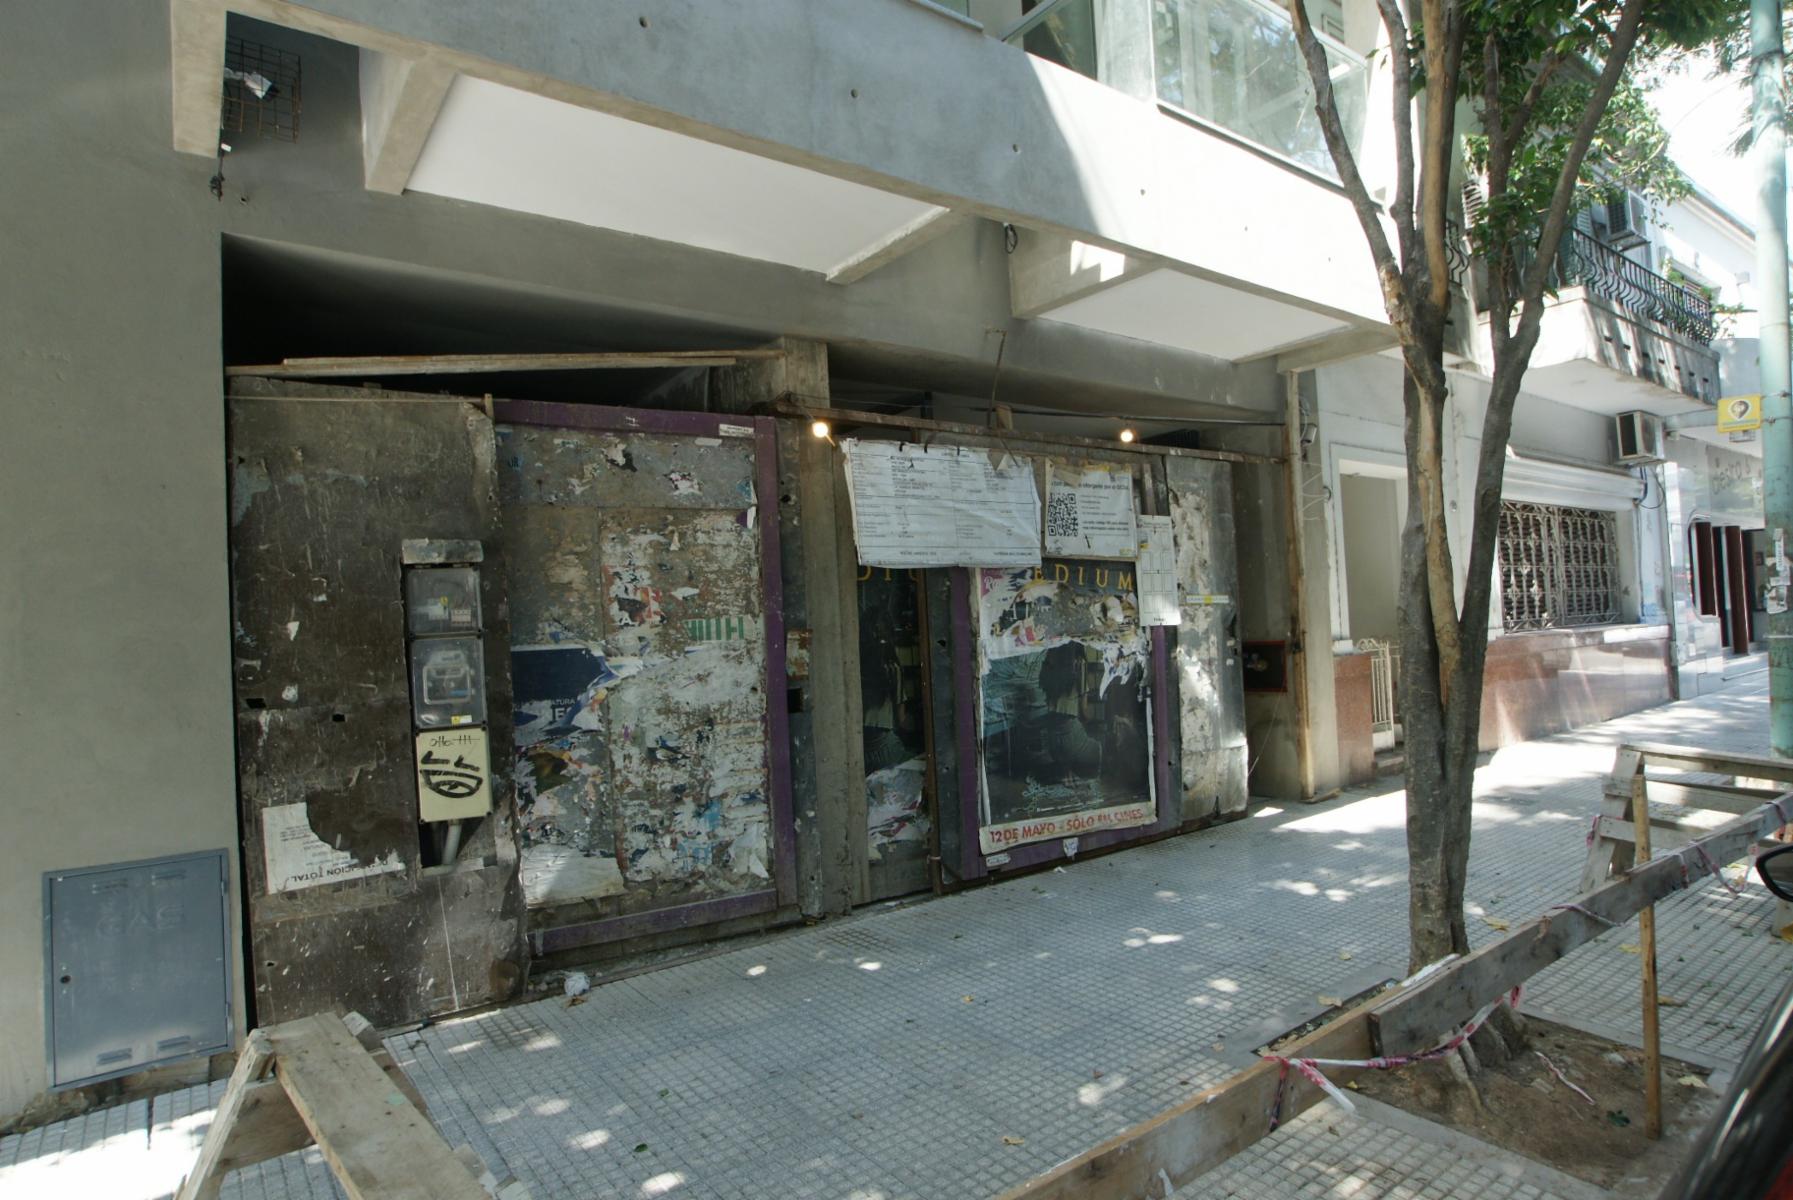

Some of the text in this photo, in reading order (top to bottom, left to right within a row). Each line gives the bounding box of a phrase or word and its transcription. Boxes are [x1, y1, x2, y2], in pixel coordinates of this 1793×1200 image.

[990, 831, 1003, 843] 12
[1003, 828, 1019, 841] DE
[1022, 822, 1056, 839] MAYO
[1066, 815, 1095, 831] SÓLO
[1114, 808, 1144, 824] CINES
